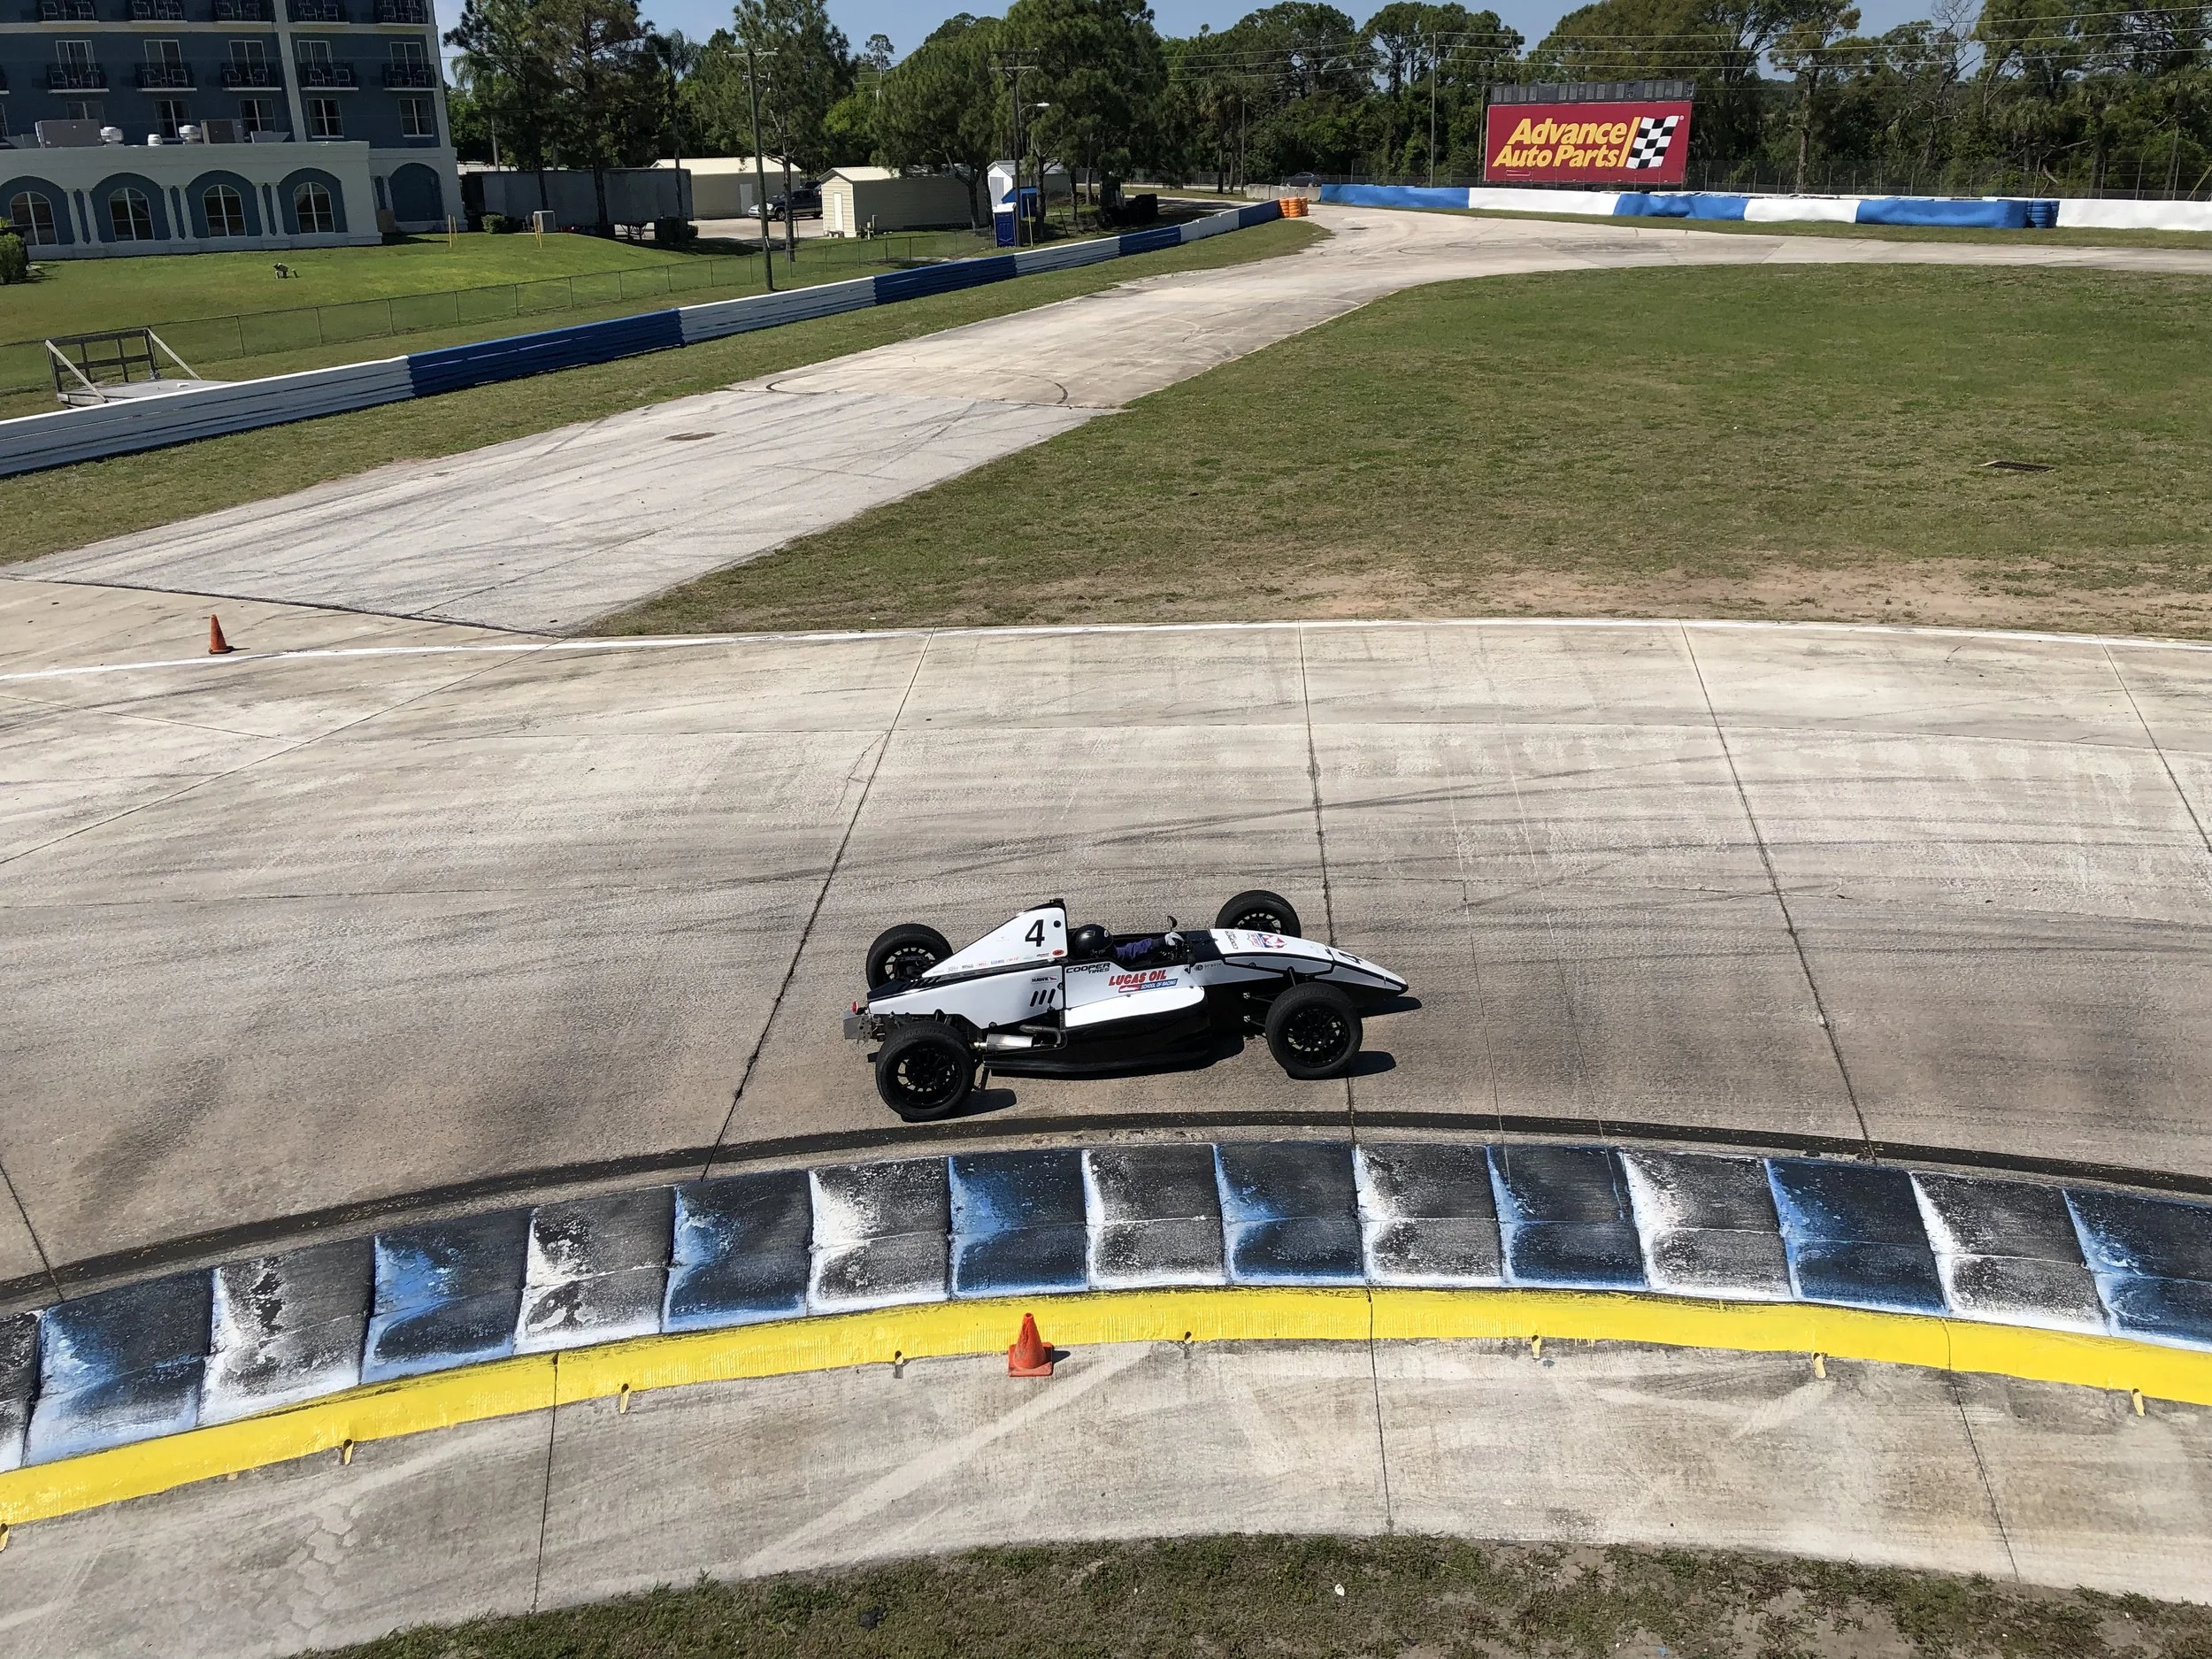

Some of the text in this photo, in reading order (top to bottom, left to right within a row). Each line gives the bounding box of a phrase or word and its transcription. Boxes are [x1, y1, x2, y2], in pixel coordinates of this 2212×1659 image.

[1507, 118, 1627, 145] Advance
[1492, 144, 1621, 167] Auto Parts
[1025, 918, 1045, 948] 4
[1066, 963, 1111, 974] COOPER
[1109, 970, 1167, 987] LUCAS OIL
